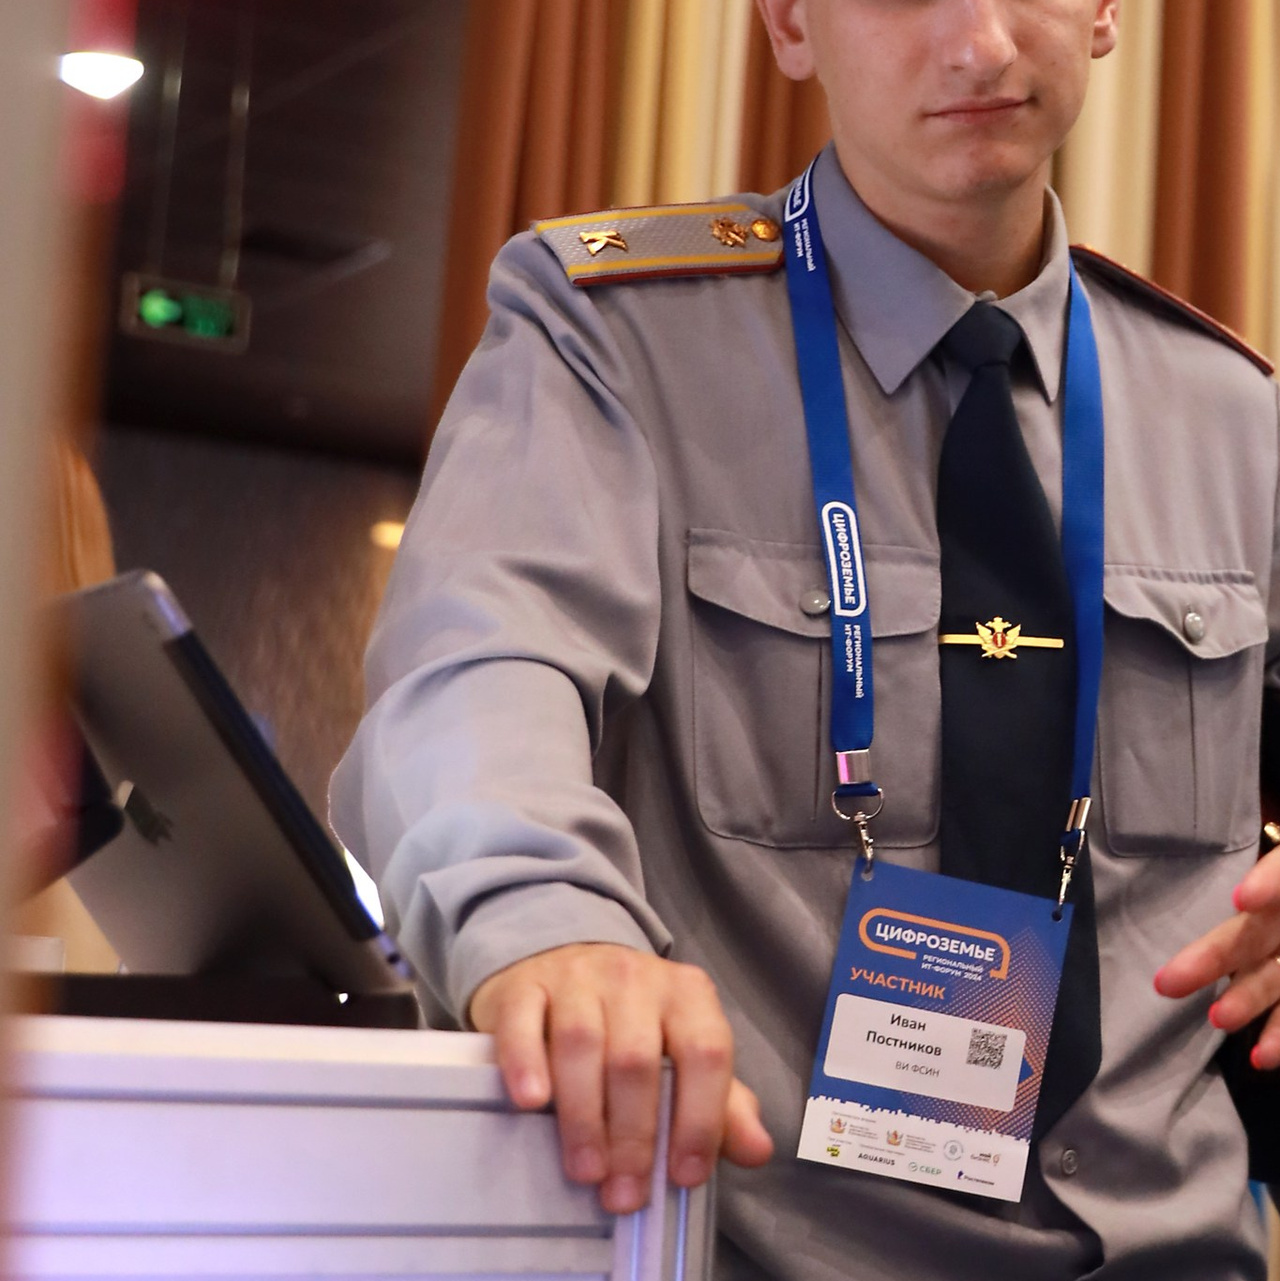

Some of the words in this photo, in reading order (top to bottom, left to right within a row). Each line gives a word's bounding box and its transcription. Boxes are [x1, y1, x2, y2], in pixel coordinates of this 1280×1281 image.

[832, 512, 856, 605] ЦИФРОЗЕМЬЕ
[844, 623, 854, 673] ИТ-ФОРУМ
[853, 624, 864, 699] РЕГИОНАЛЬНЫЙ
[875, 923, 996, 962] ЦИФРОЗЕМЬЕ
[921, 962, 961, 977] ИТ-ФОРУМ
[922, 954, 984, 972] РЕГИОНАЛЬНЫЙ
[850, 967, 946, 1000] УЧАСТНИК
[890, 1013, 926, 1031] Иван
[866, 1030, 942, 1057] Постников
[911, 1064, 940, 1077] ФСИН
[858, 1153, 895, 1166] AQUARIUS
